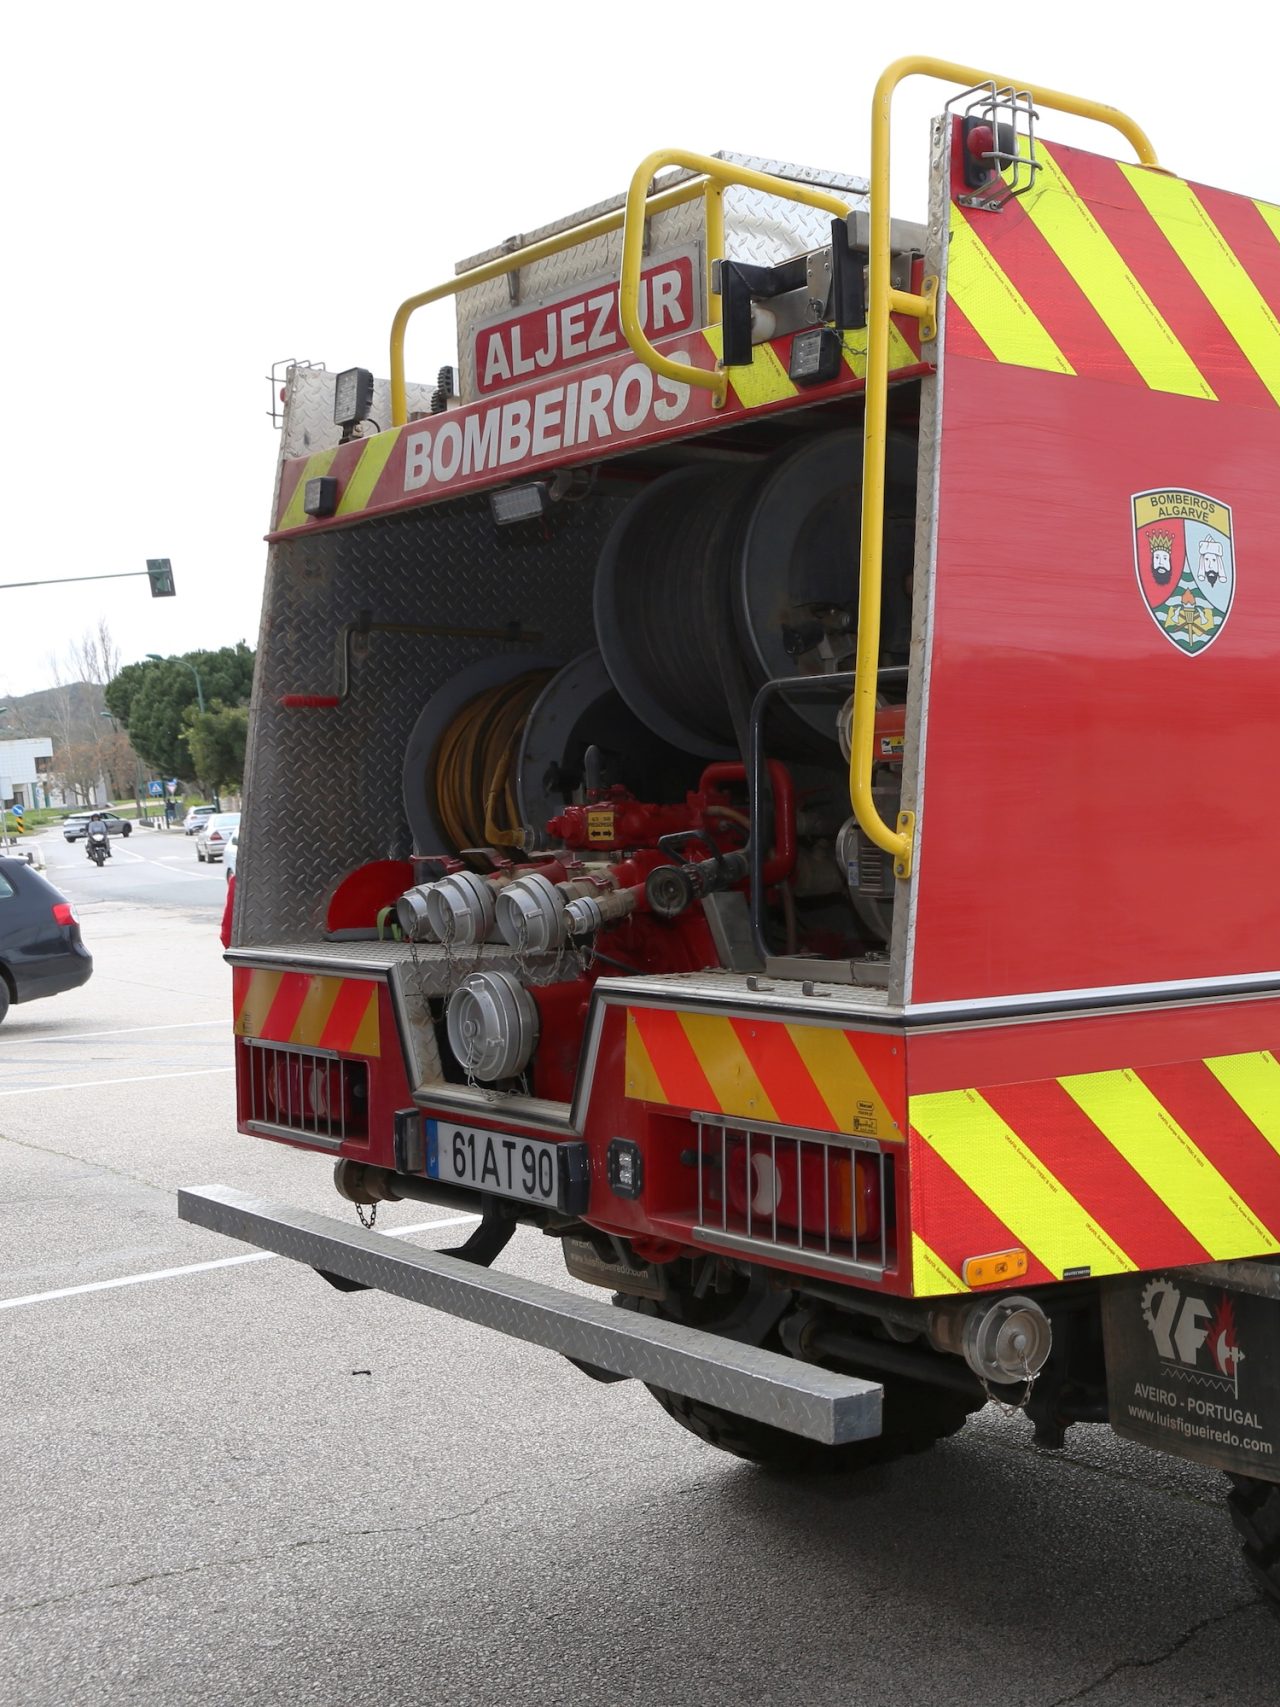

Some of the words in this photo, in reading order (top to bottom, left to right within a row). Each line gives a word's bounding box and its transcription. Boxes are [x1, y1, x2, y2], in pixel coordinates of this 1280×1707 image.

[404, 350, 692, 492] BOMBEIROS
[1150, 493, 1216, 514] BOMBEIROS
[1157, 505, 1210, 523] ALGARVE
[1127, 1404, 1274, 1455] www.luisfigueiredo.com
[1134, 1382, 1177, 1407] AVEIRO
[1186, 1398, 1264, 1430] PORTUGAL
